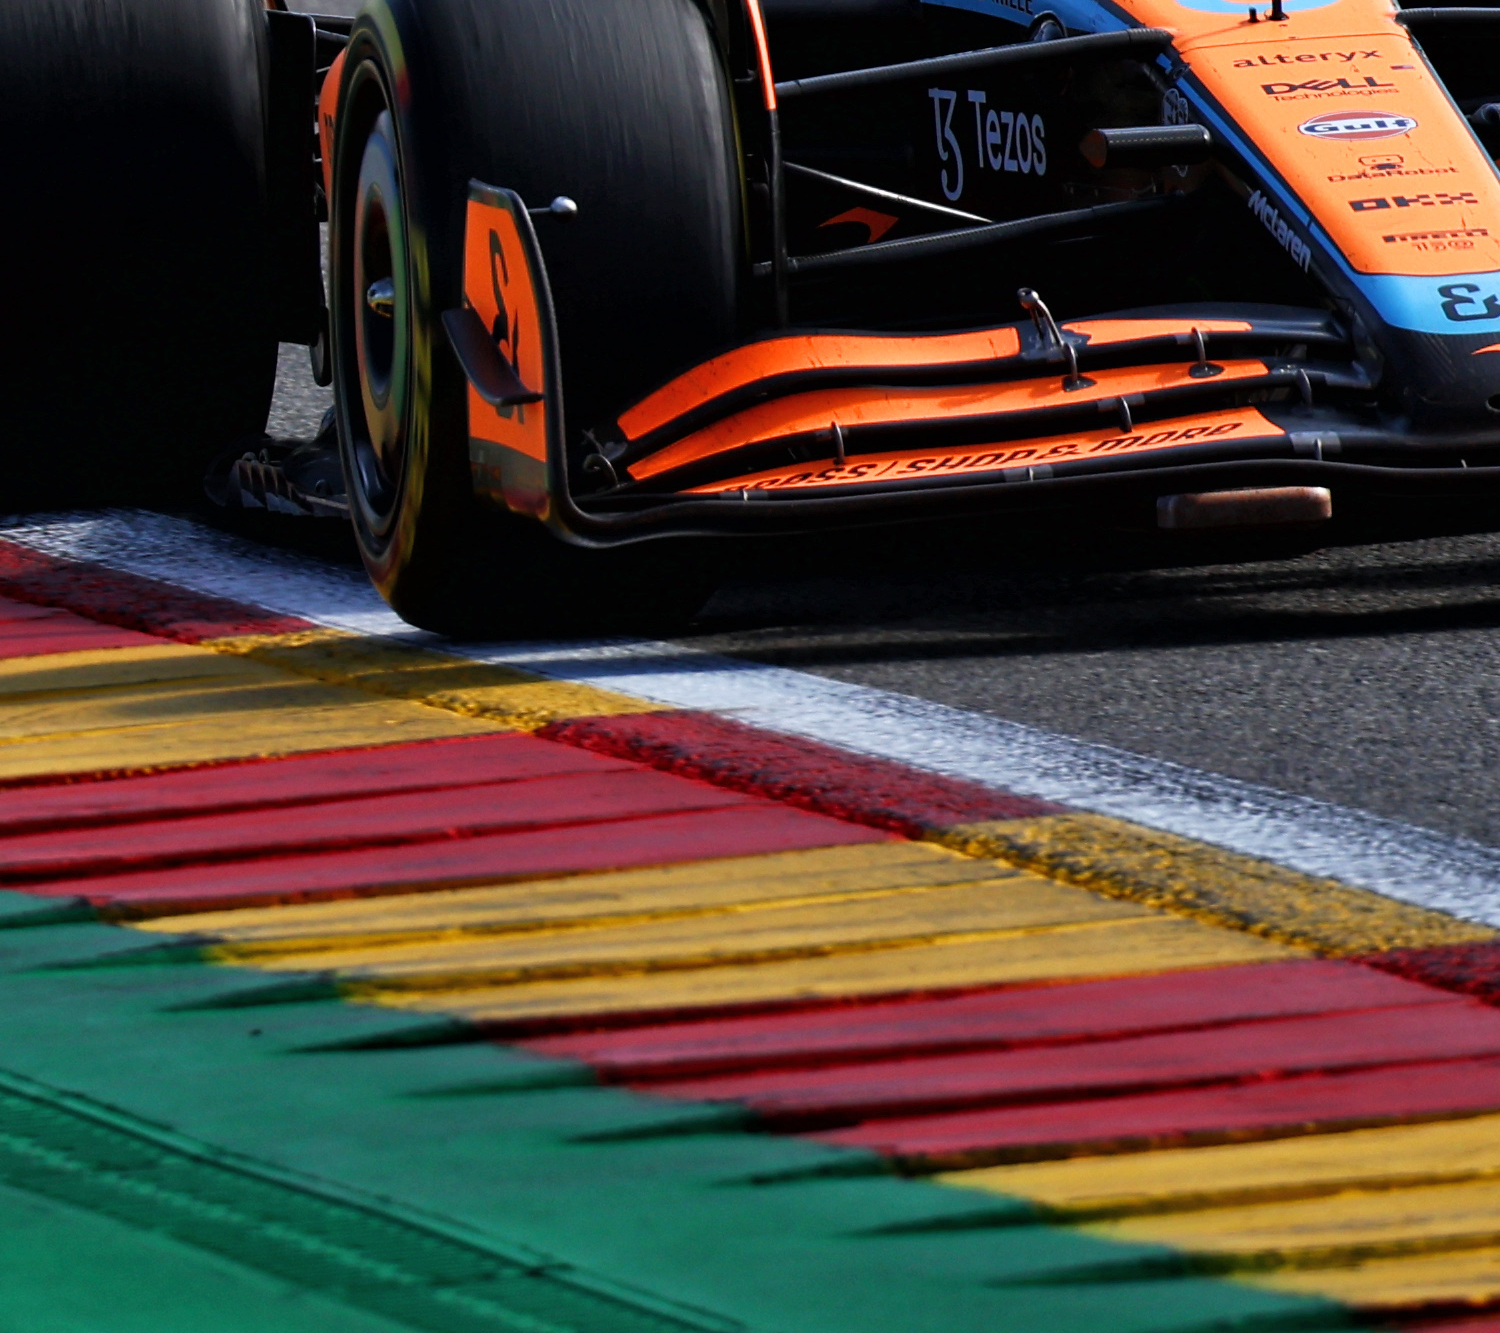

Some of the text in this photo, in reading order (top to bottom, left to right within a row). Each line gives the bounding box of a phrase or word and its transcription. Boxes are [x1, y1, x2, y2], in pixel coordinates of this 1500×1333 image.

[1233, 48, 1384, 69] alteryx
[1260, 76, 1395, 96] DELL
[1272, 86, 1400, 103] Technologies
[967, 90, 1047, 177] Tezos
[1303, 117, 1413, 134] Gulf
[1326, 166, 1460, 183] DataRobot
[1347, 192, 1479, 213] OKX
[1248, 188, 1313, 273] McLaren
[897, 448, 1038, 475] SHOP
